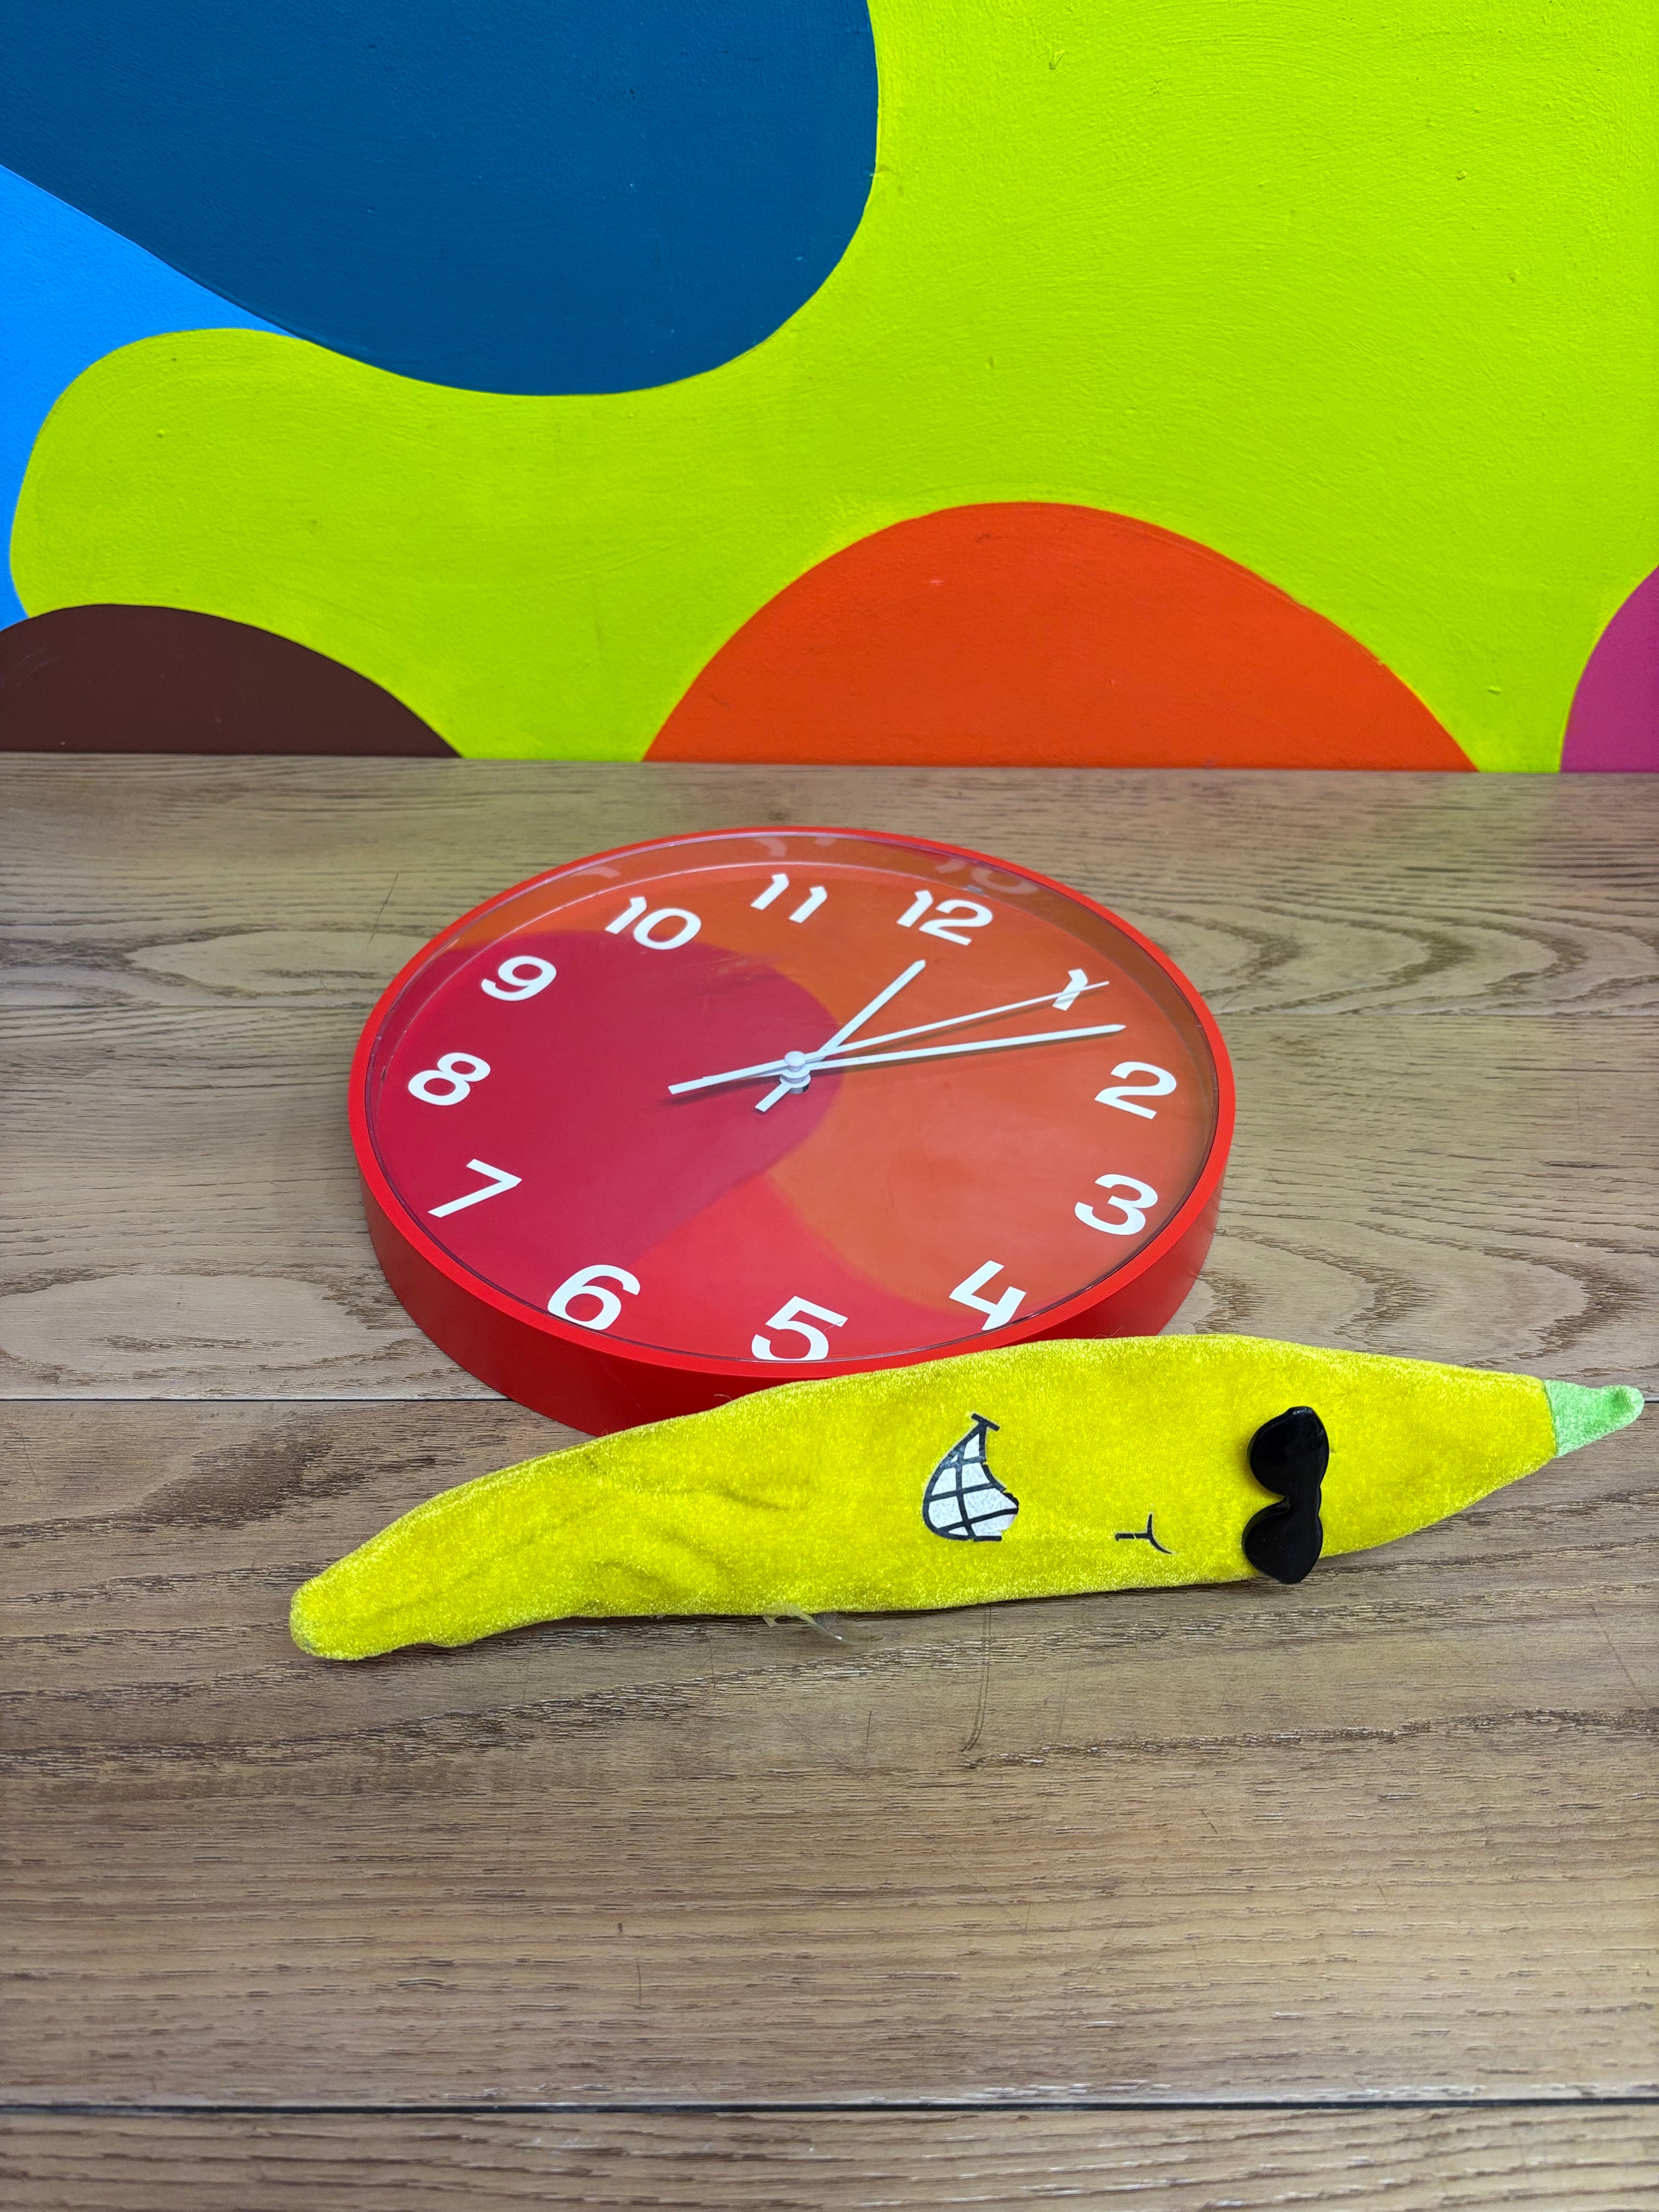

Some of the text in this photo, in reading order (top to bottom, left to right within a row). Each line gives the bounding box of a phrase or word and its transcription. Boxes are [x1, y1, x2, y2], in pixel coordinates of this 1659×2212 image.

[605, 896, 702, 950] 10
[751, 873, 827, 923] 11
[896, 890, 993, 946] 12
[481, 956, 557, 1001] 9
[1053, 969, 1088, 1011] 1
[408, 1052, 491, 1106] 8
[1094, 1061, 1177, 1120] 2
[428, 1159, 522, 1218] 7
[1074, 1173, 1159, 1235] 3
[547, 1264, 641, 1330] 6
[949, 1260, 1026, 1331] 4
[751, 1295, 848, 1361] 5
